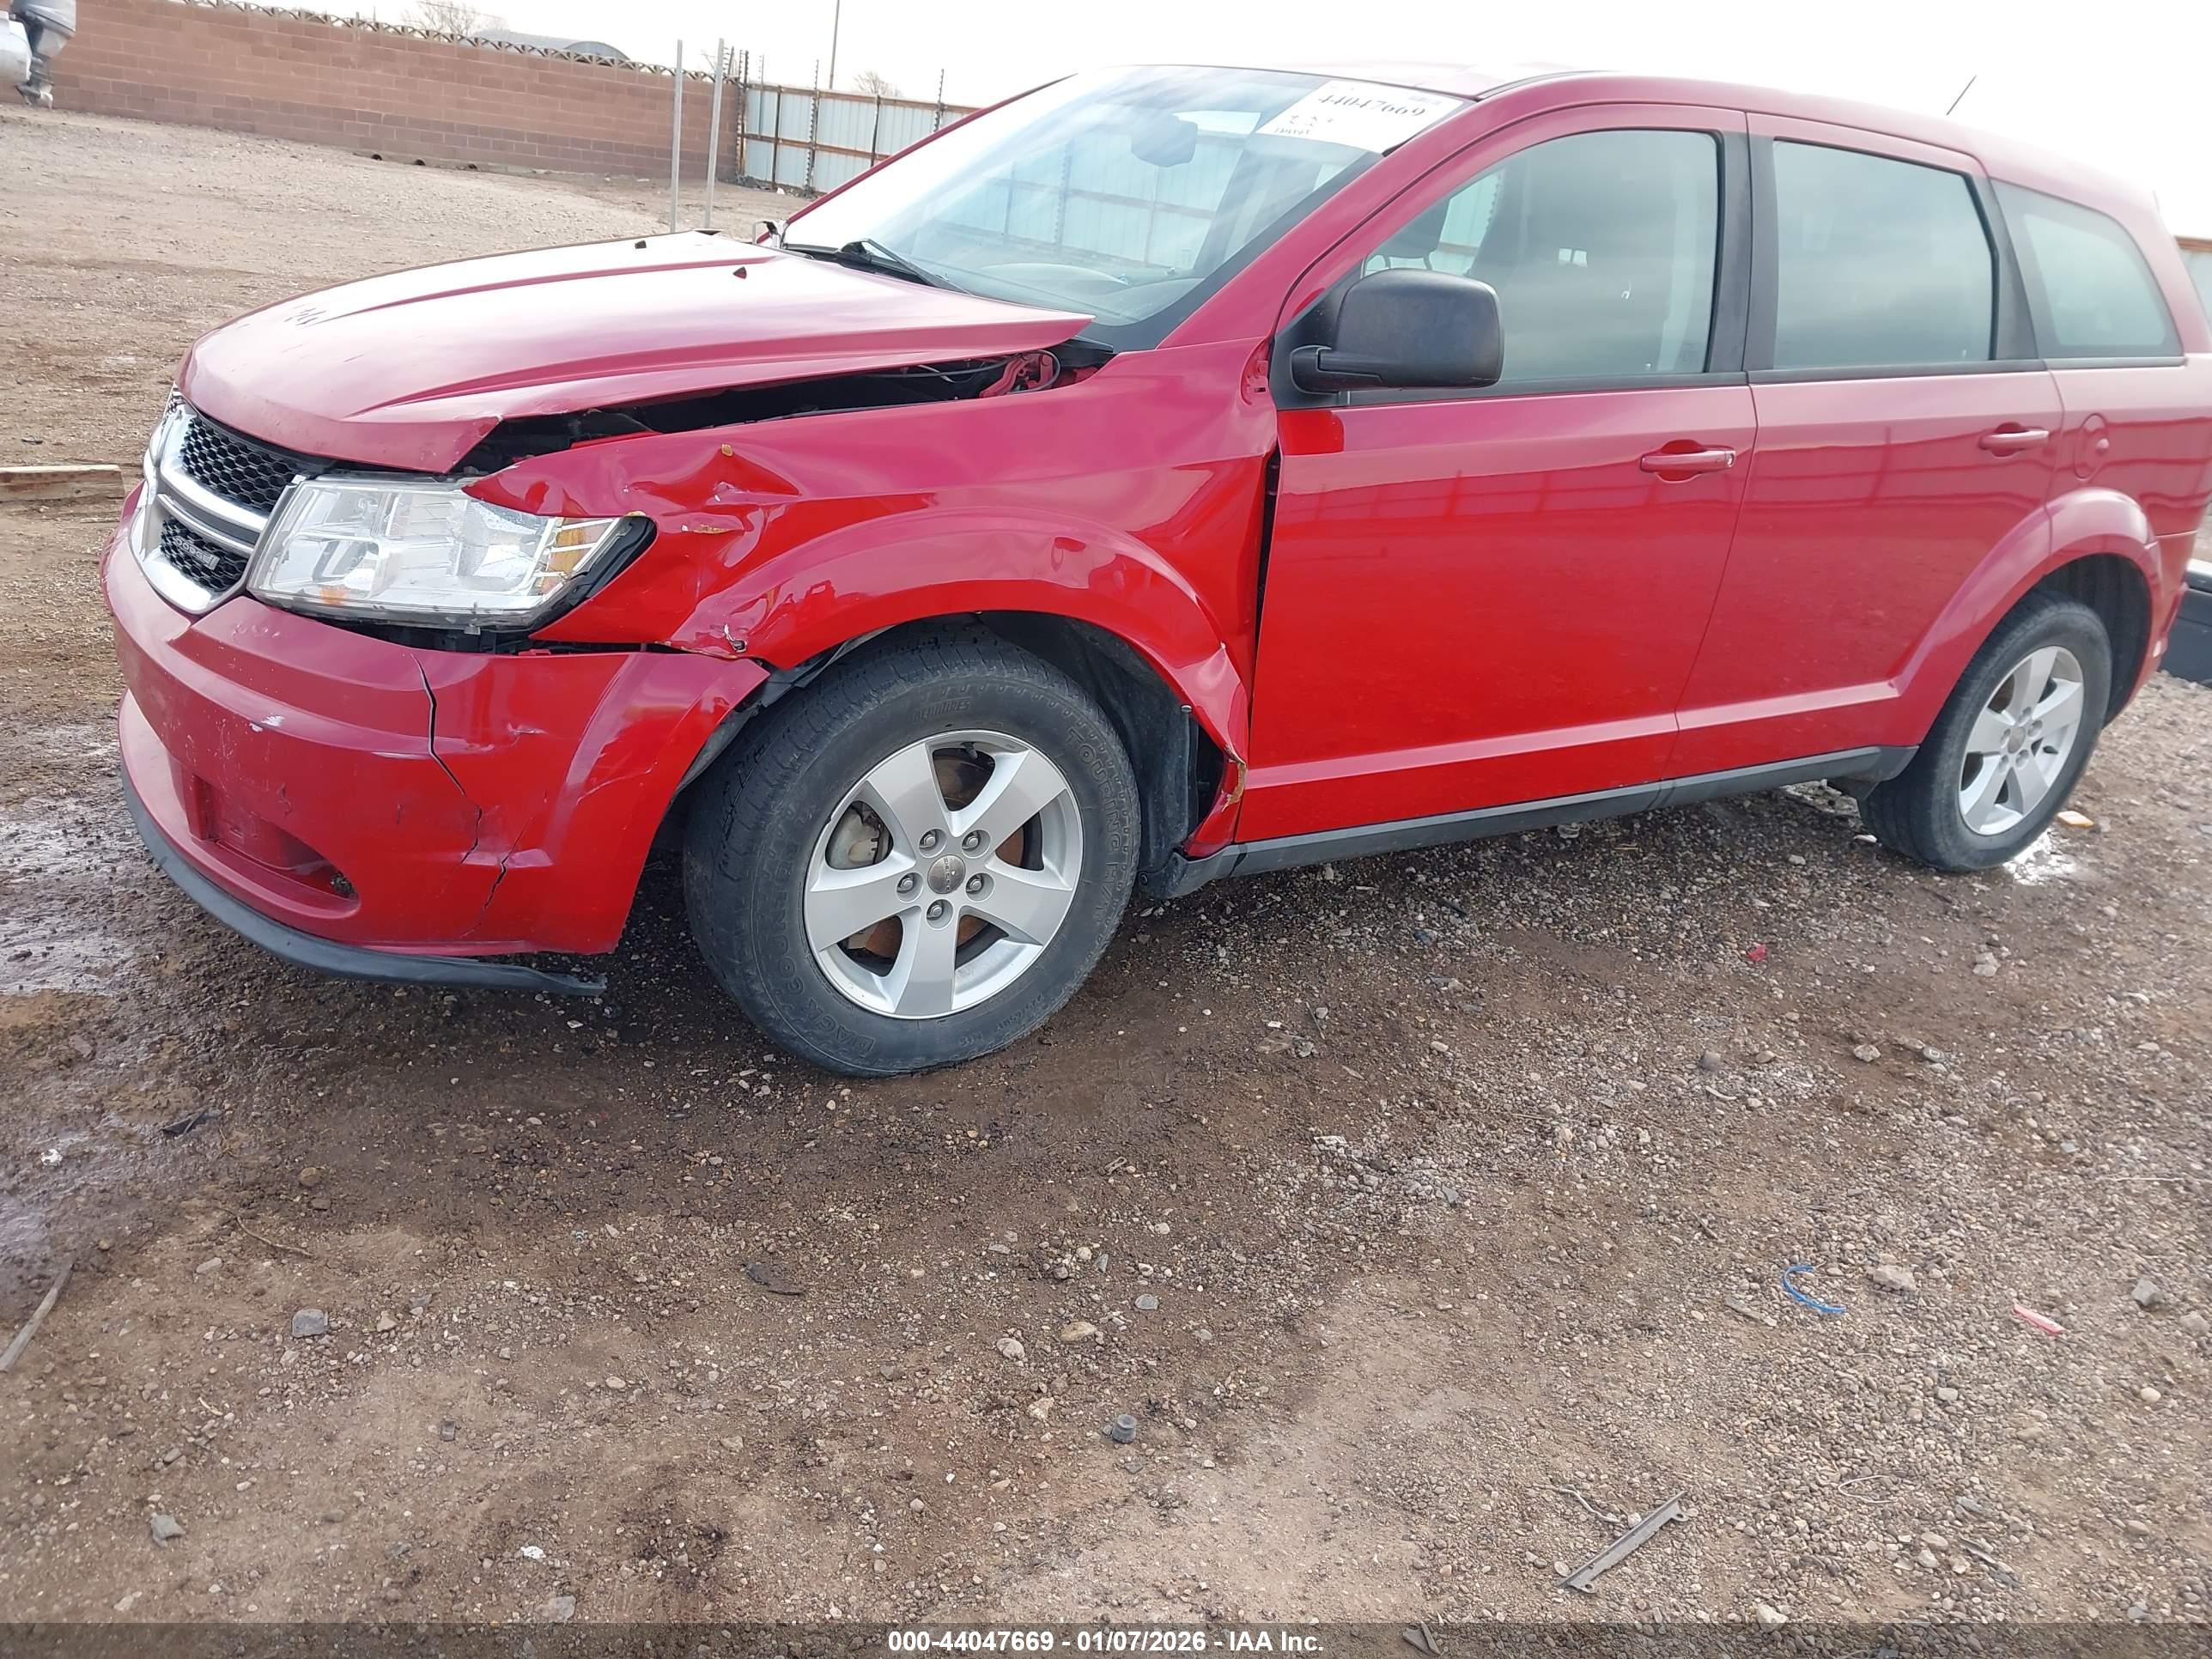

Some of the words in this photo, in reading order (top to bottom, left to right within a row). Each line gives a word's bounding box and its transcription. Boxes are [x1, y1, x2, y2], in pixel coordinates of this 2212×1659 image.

[1319, 94, 1426, 117] 44047669
[174, 537, 214, 566] DODGE
[1066, 726, 1122, 854] TOURING
